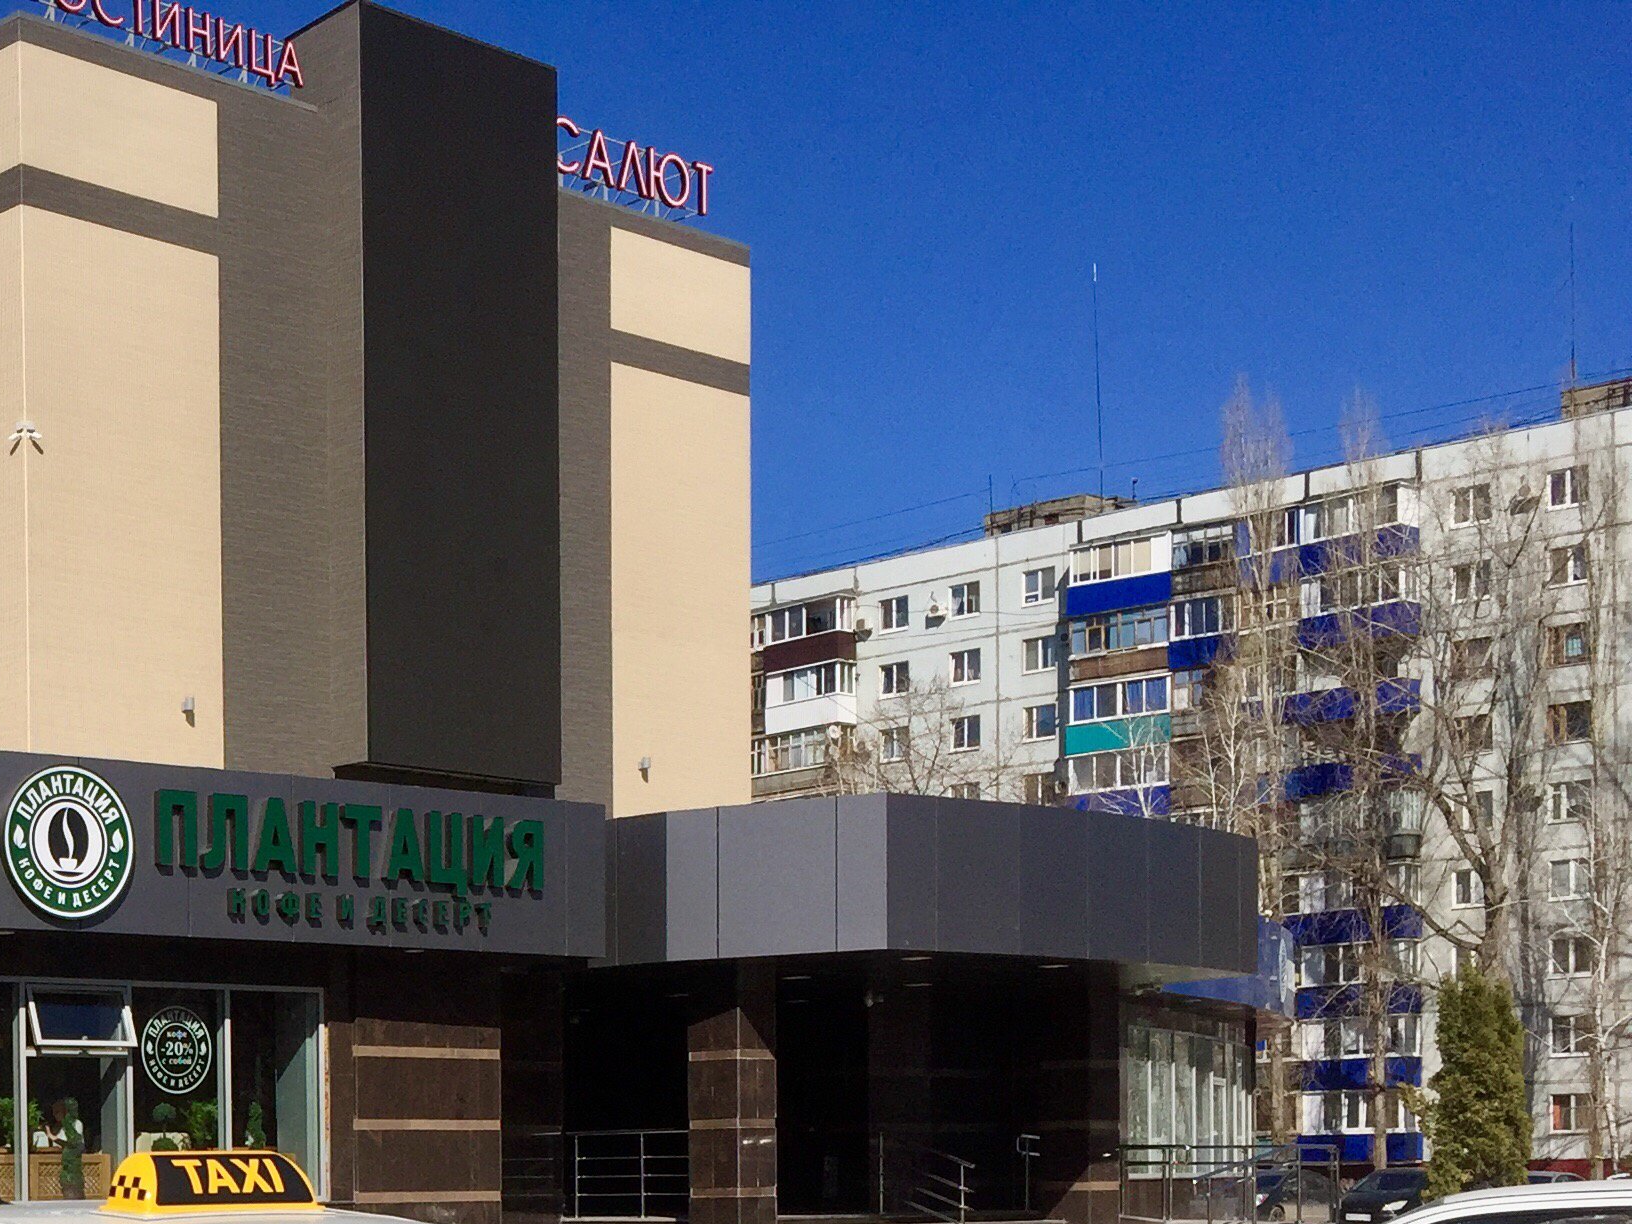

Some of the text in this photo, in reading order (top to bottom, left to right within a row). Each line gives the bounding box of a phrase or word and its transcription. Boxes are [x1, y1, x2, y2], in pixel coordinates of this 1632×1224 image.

[557, 115, 714, 216] САЛЮТ
[16, 774, 120, 825] ПЛАНТАЦИЯ
[155, 788, 545, 899] ПЛАНТАЦИЯ
[18, 857, 53, 900] КОФЕ
[72, 858, 120, 908] ДЕСЕРТ
[227, 888, 324, 929] КОФЕ
[368, 896, 494, 938] ДЕСЕРТ
[160, 1041, 194, 1056] -20%
[170, 1158, 285, 1195] TAXI
